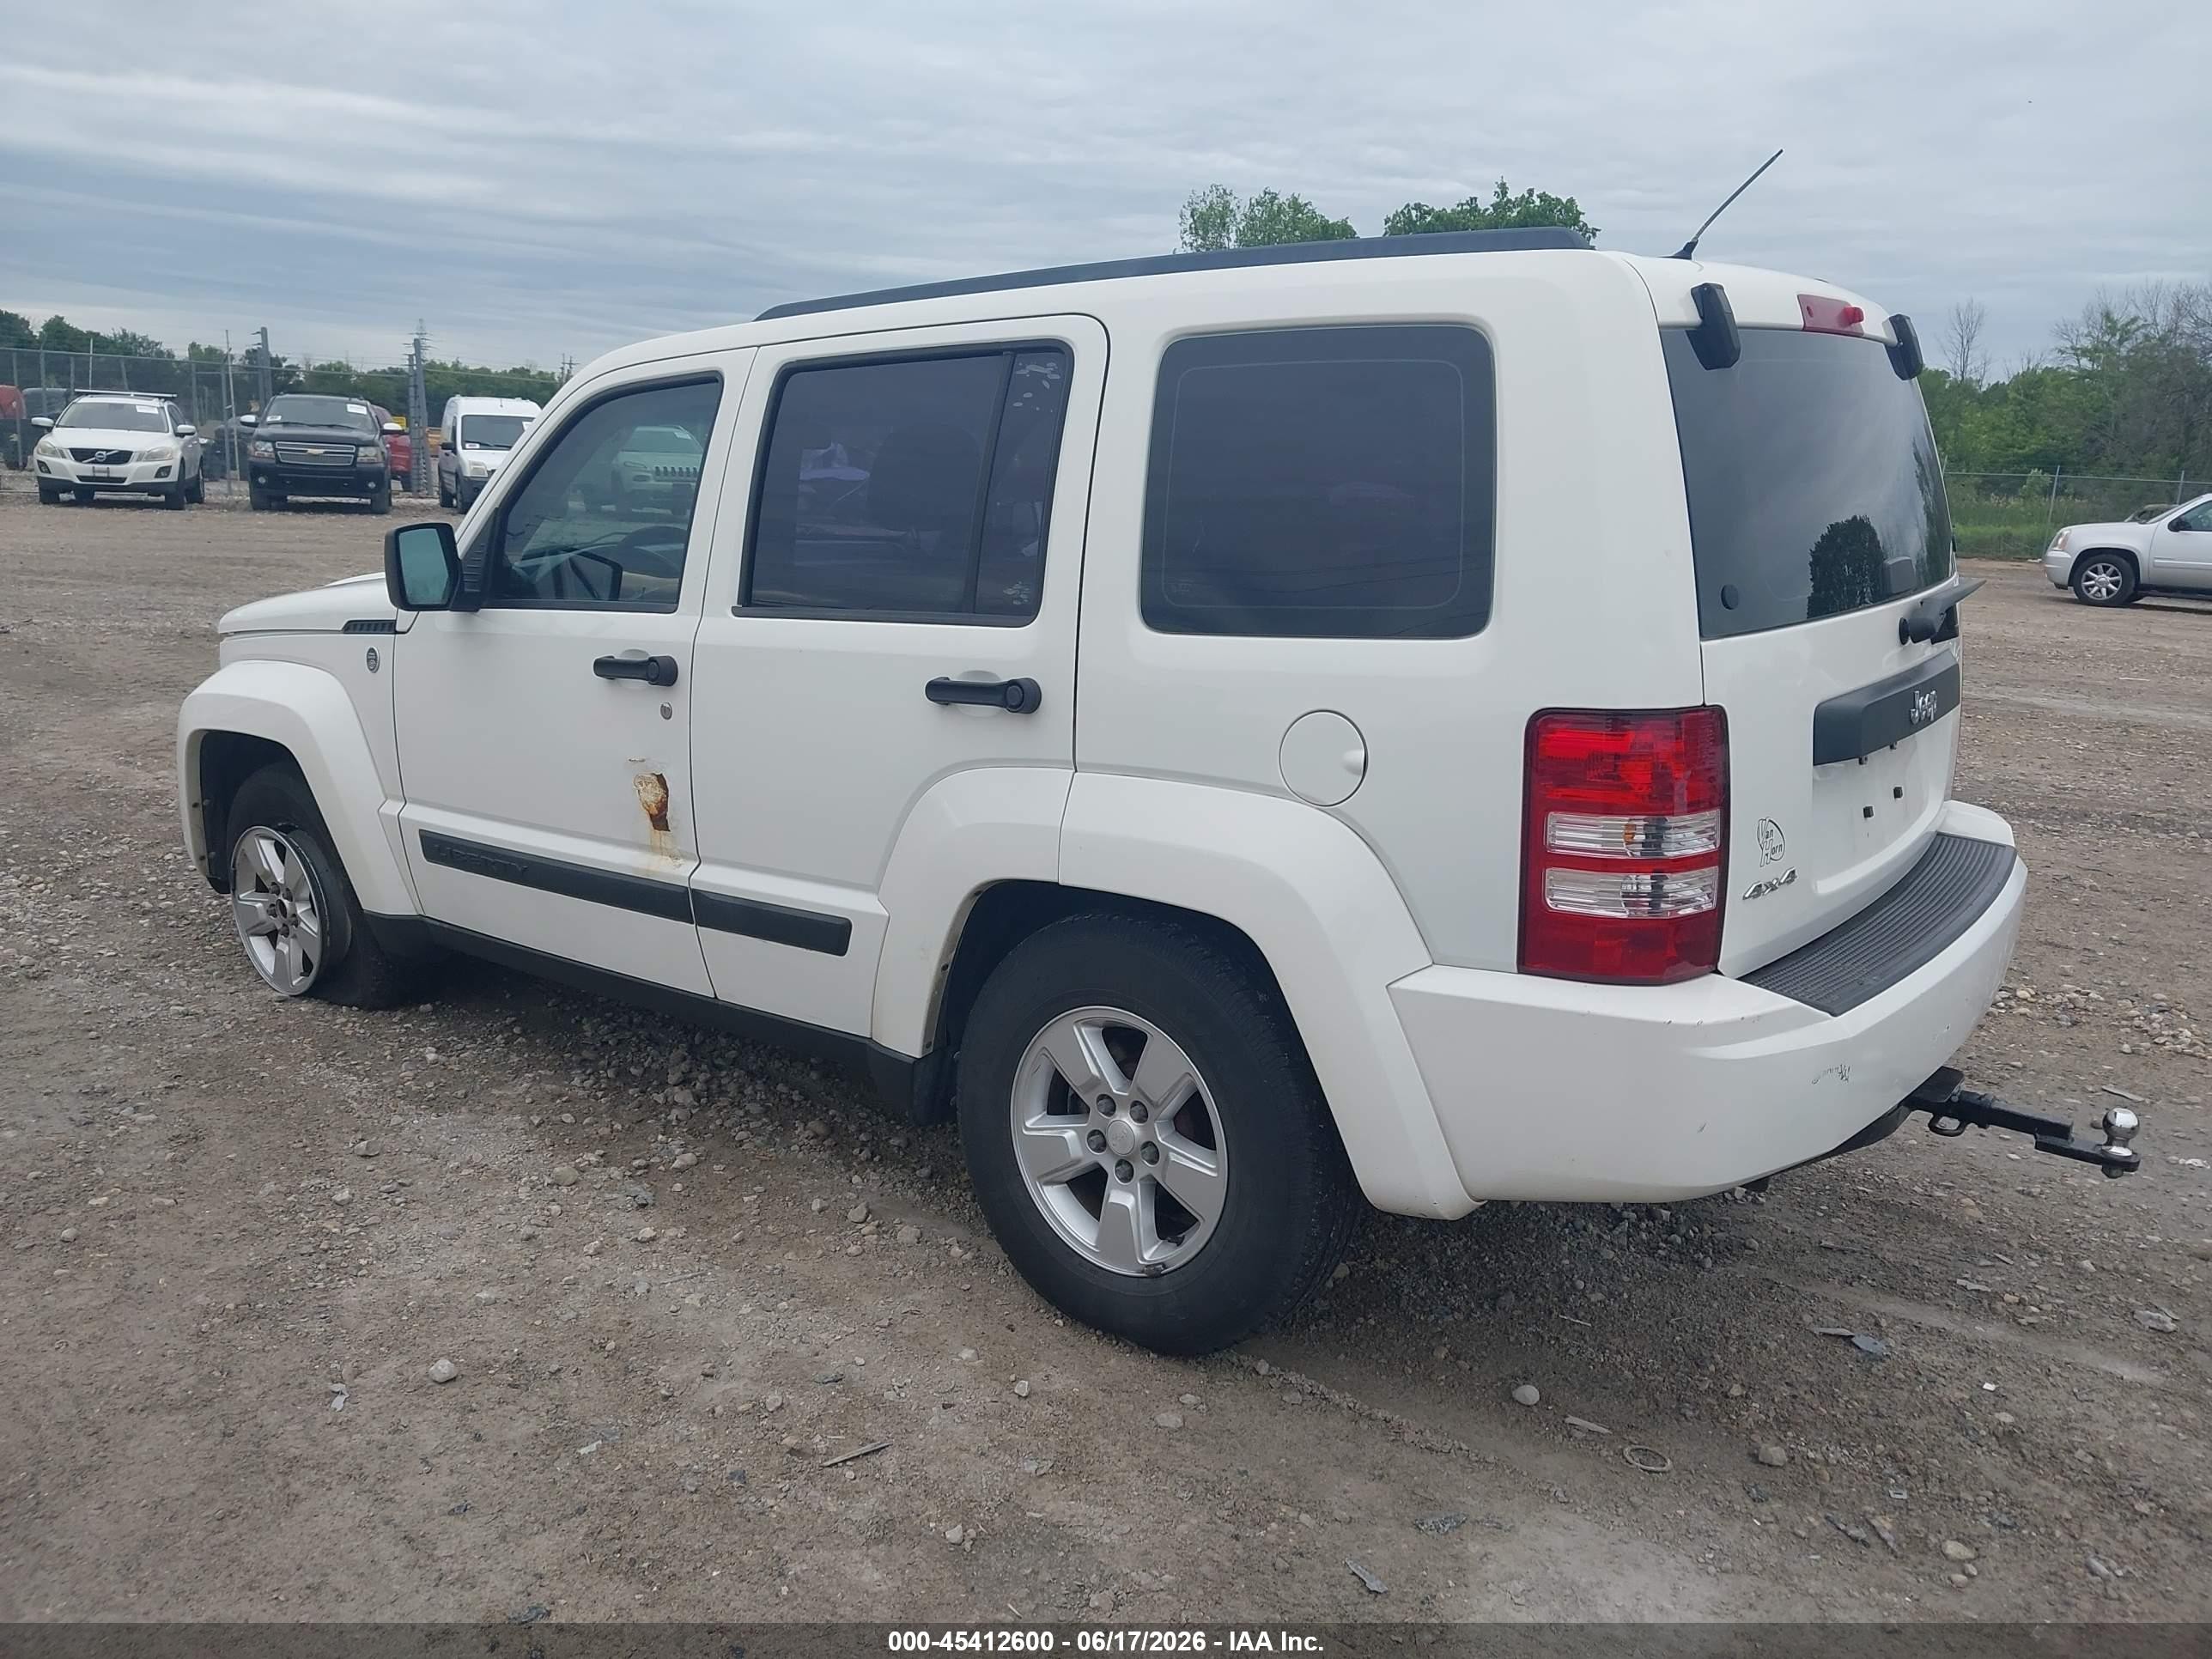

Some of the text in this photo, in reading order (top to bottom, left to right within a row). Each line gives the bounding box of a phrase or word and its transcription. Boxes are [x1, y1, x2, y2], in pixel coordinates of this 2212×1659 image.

[1909, 690, 1938, 725] Jeep
[1758, 816, 1774, 841] Van
[1759, 835, 1783, 868] Horn
[1741, 866, 1798, 901] 4x4
